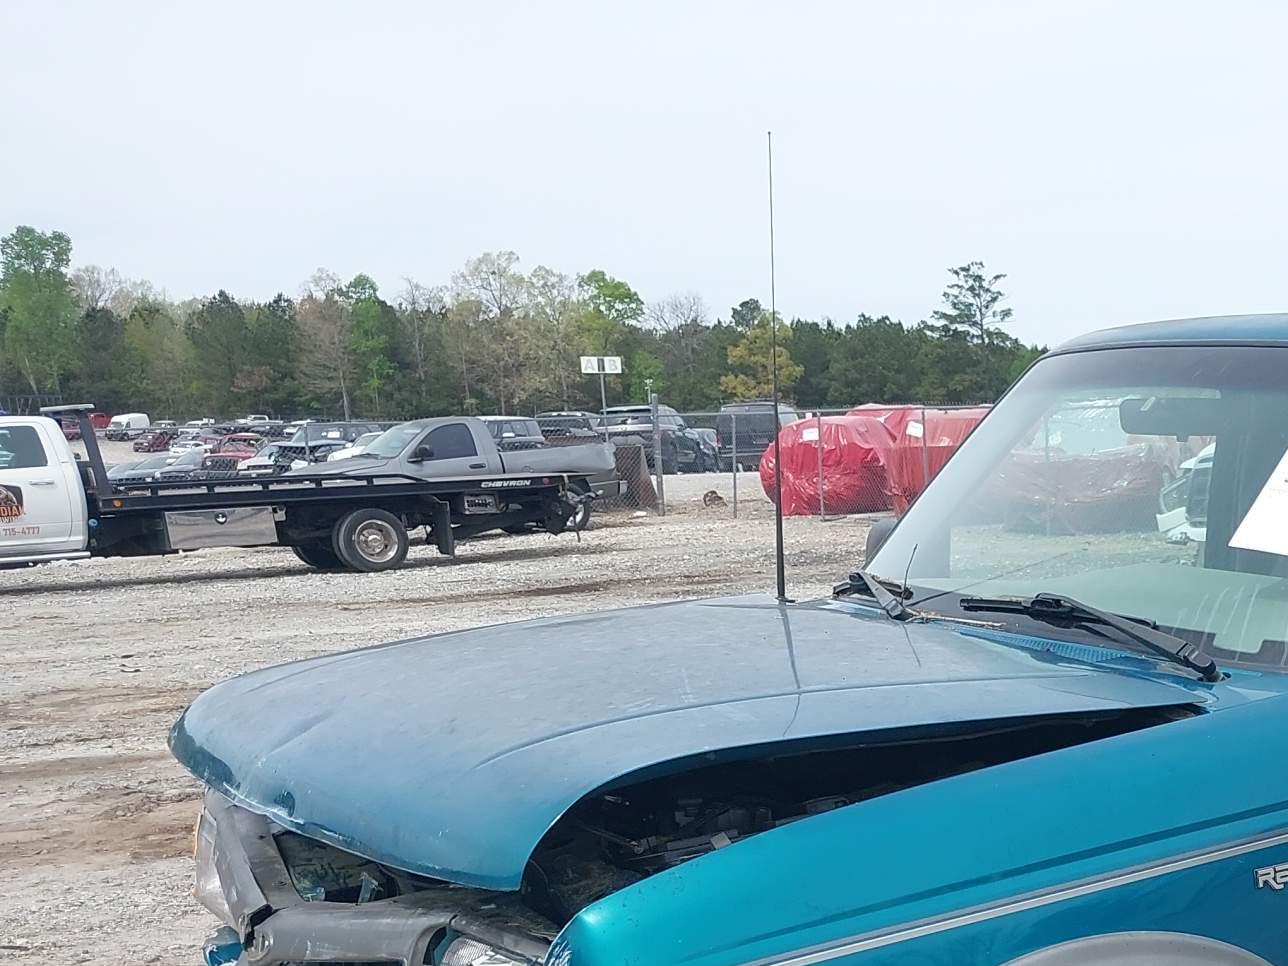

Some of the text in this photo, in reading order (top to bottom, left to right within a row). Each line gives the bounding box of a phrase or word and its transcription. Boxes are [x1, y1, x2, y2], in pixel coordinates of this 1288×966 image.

[584, 359, 618, 371] A B
[481, 480, 531, 488] CHEVRON
